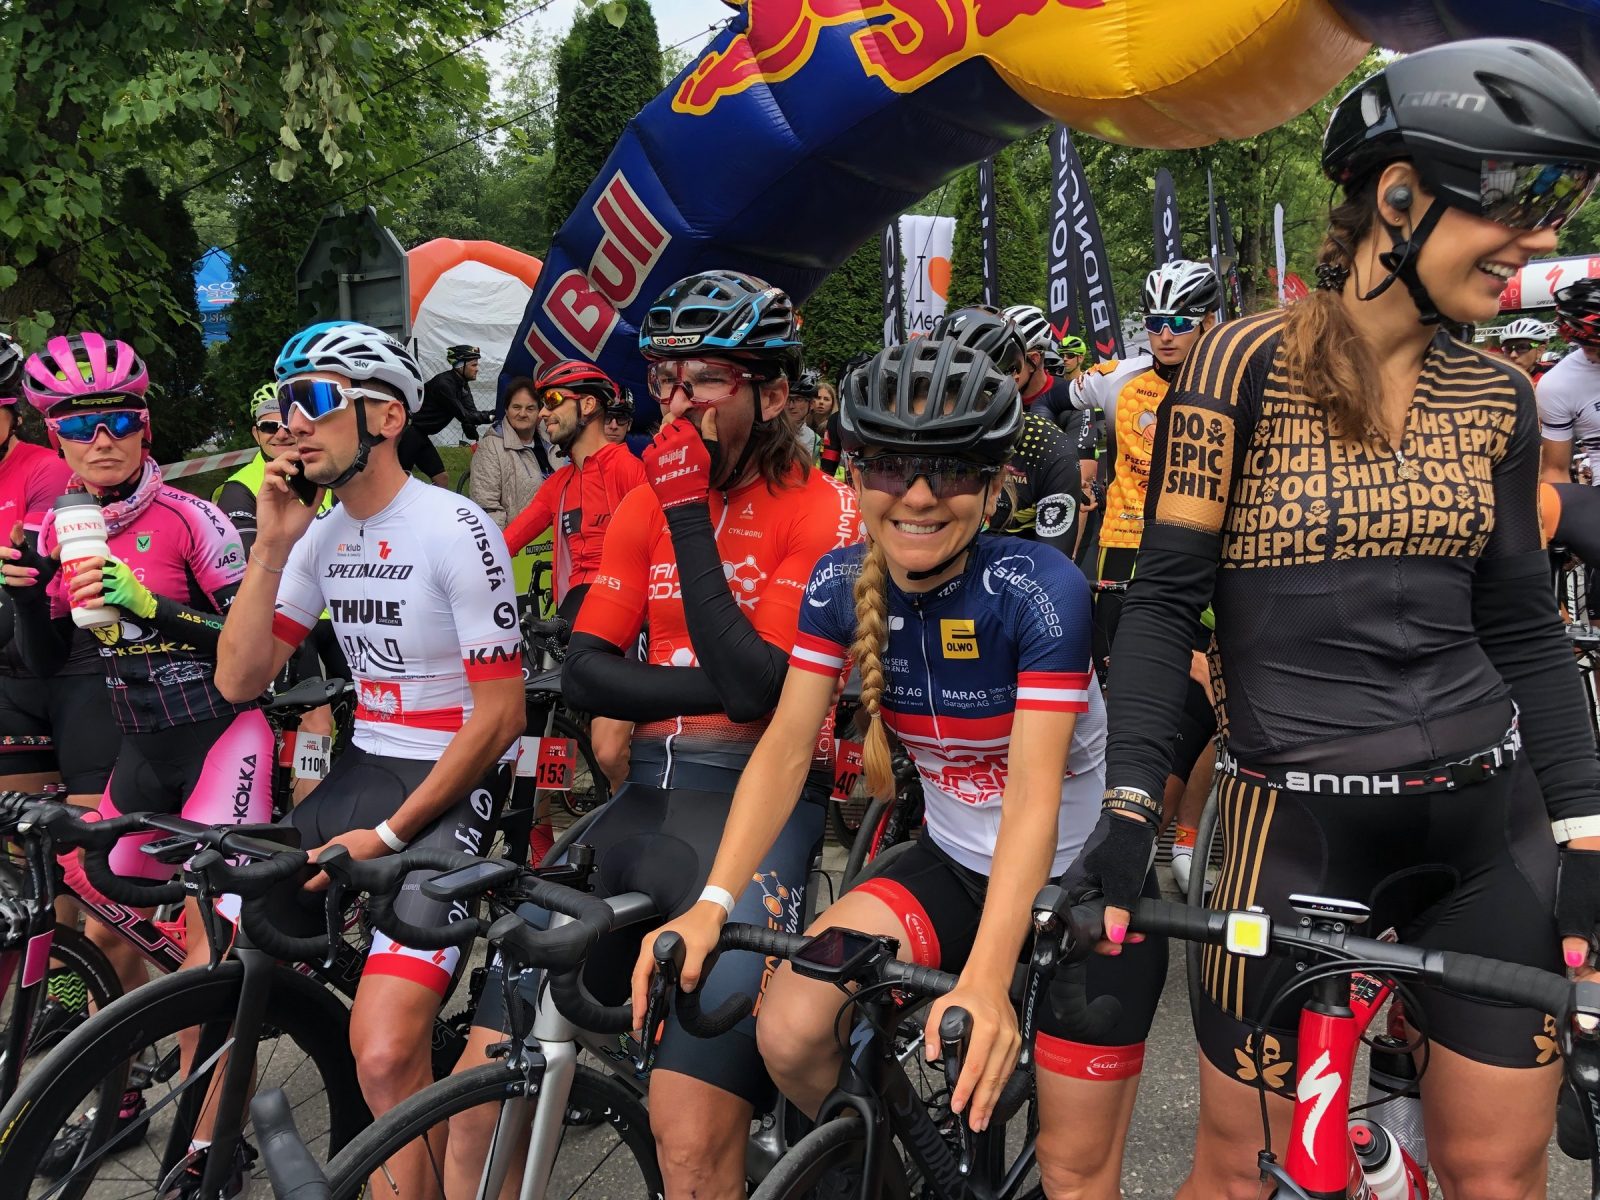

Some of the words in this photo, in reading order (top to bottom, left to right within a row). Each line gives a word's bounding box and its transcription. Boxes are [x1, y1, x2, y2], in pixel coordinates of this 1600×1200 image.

[543, 170, 670, 359] Bull
[656, 335, 695, 347] SUOMY
[354, 359, 369, 369] sky
[1171, 411, 1205, 440] DO
[1170, 441, 1223, 476] EPIC
[1329, 437, 1394, 463] EPIC
[655, 465, 700, 485] TREK
[1166, 468, 1225, 503] SHIT.
[1408, 482, 1454, 508] DO
[1260, 502, 1302, 530] DO
[1412, 508, 1475, 537] EPIC
[1258, 528, 1327, 556] EPIC
[215, 552, 237, 569] JAS
[325, 563, 413, 580] SPECIALIZED
[330, 599, 401, 624] THULE
[946, 642, 973, 651] OLWO
[906, 688, 922, 697] AG
[942, 689, 987, 700] MARAG
[943, 700, 975, 709] Garagen
[538, 762, 567, 784] 153
[1285, 771, 1399, 794] HUUB
[1119, 791, 1142, 803] EPIC
